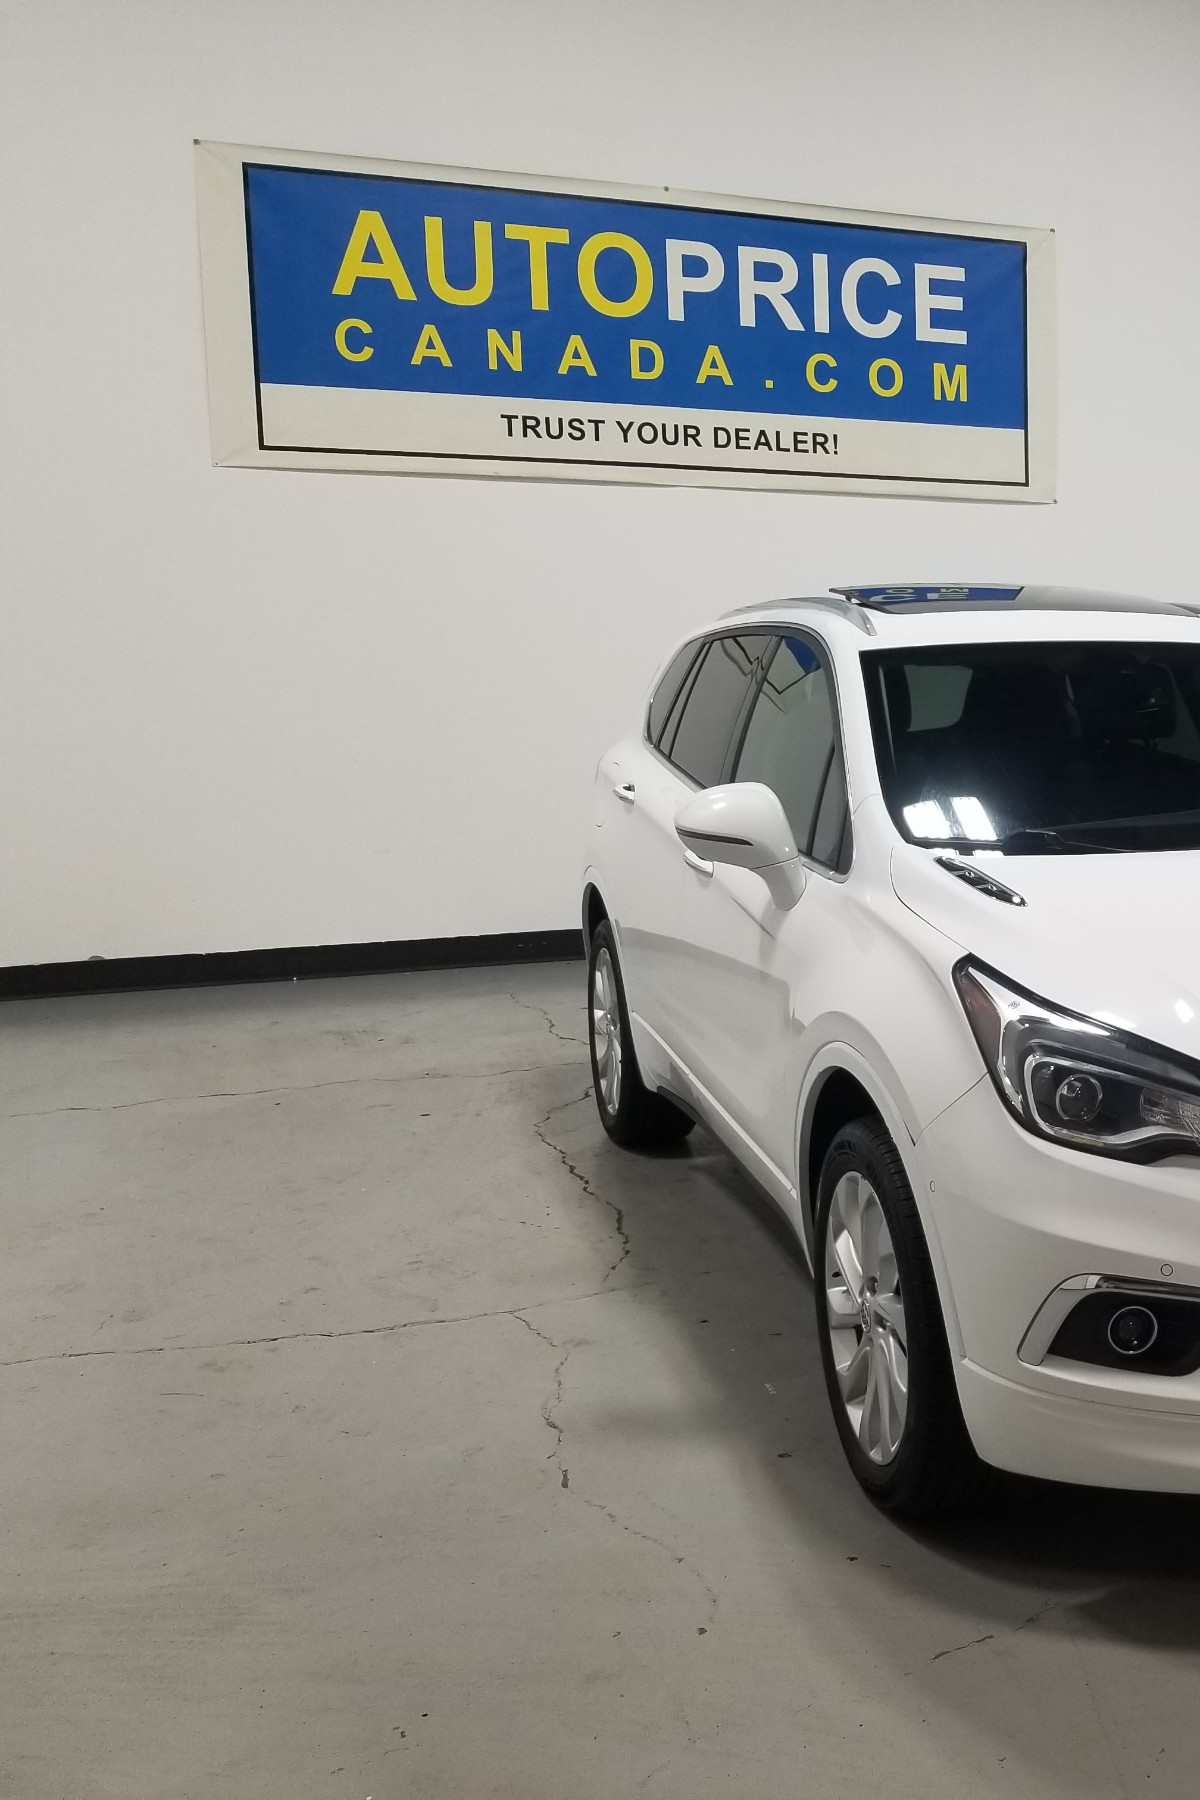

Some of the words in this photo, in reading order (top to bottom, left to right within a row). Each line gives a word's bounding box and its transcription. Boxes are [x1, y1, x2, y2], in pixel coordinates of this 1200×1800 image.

[331, 209, 968, 345] AUTOPRICE
[334, 318, 968, 402] CANADA.COM
[500, 413, 606, 442] TRUST
[615, 420, 703, 448] YOUR
[713, 426, 839, 456] DEALER!
